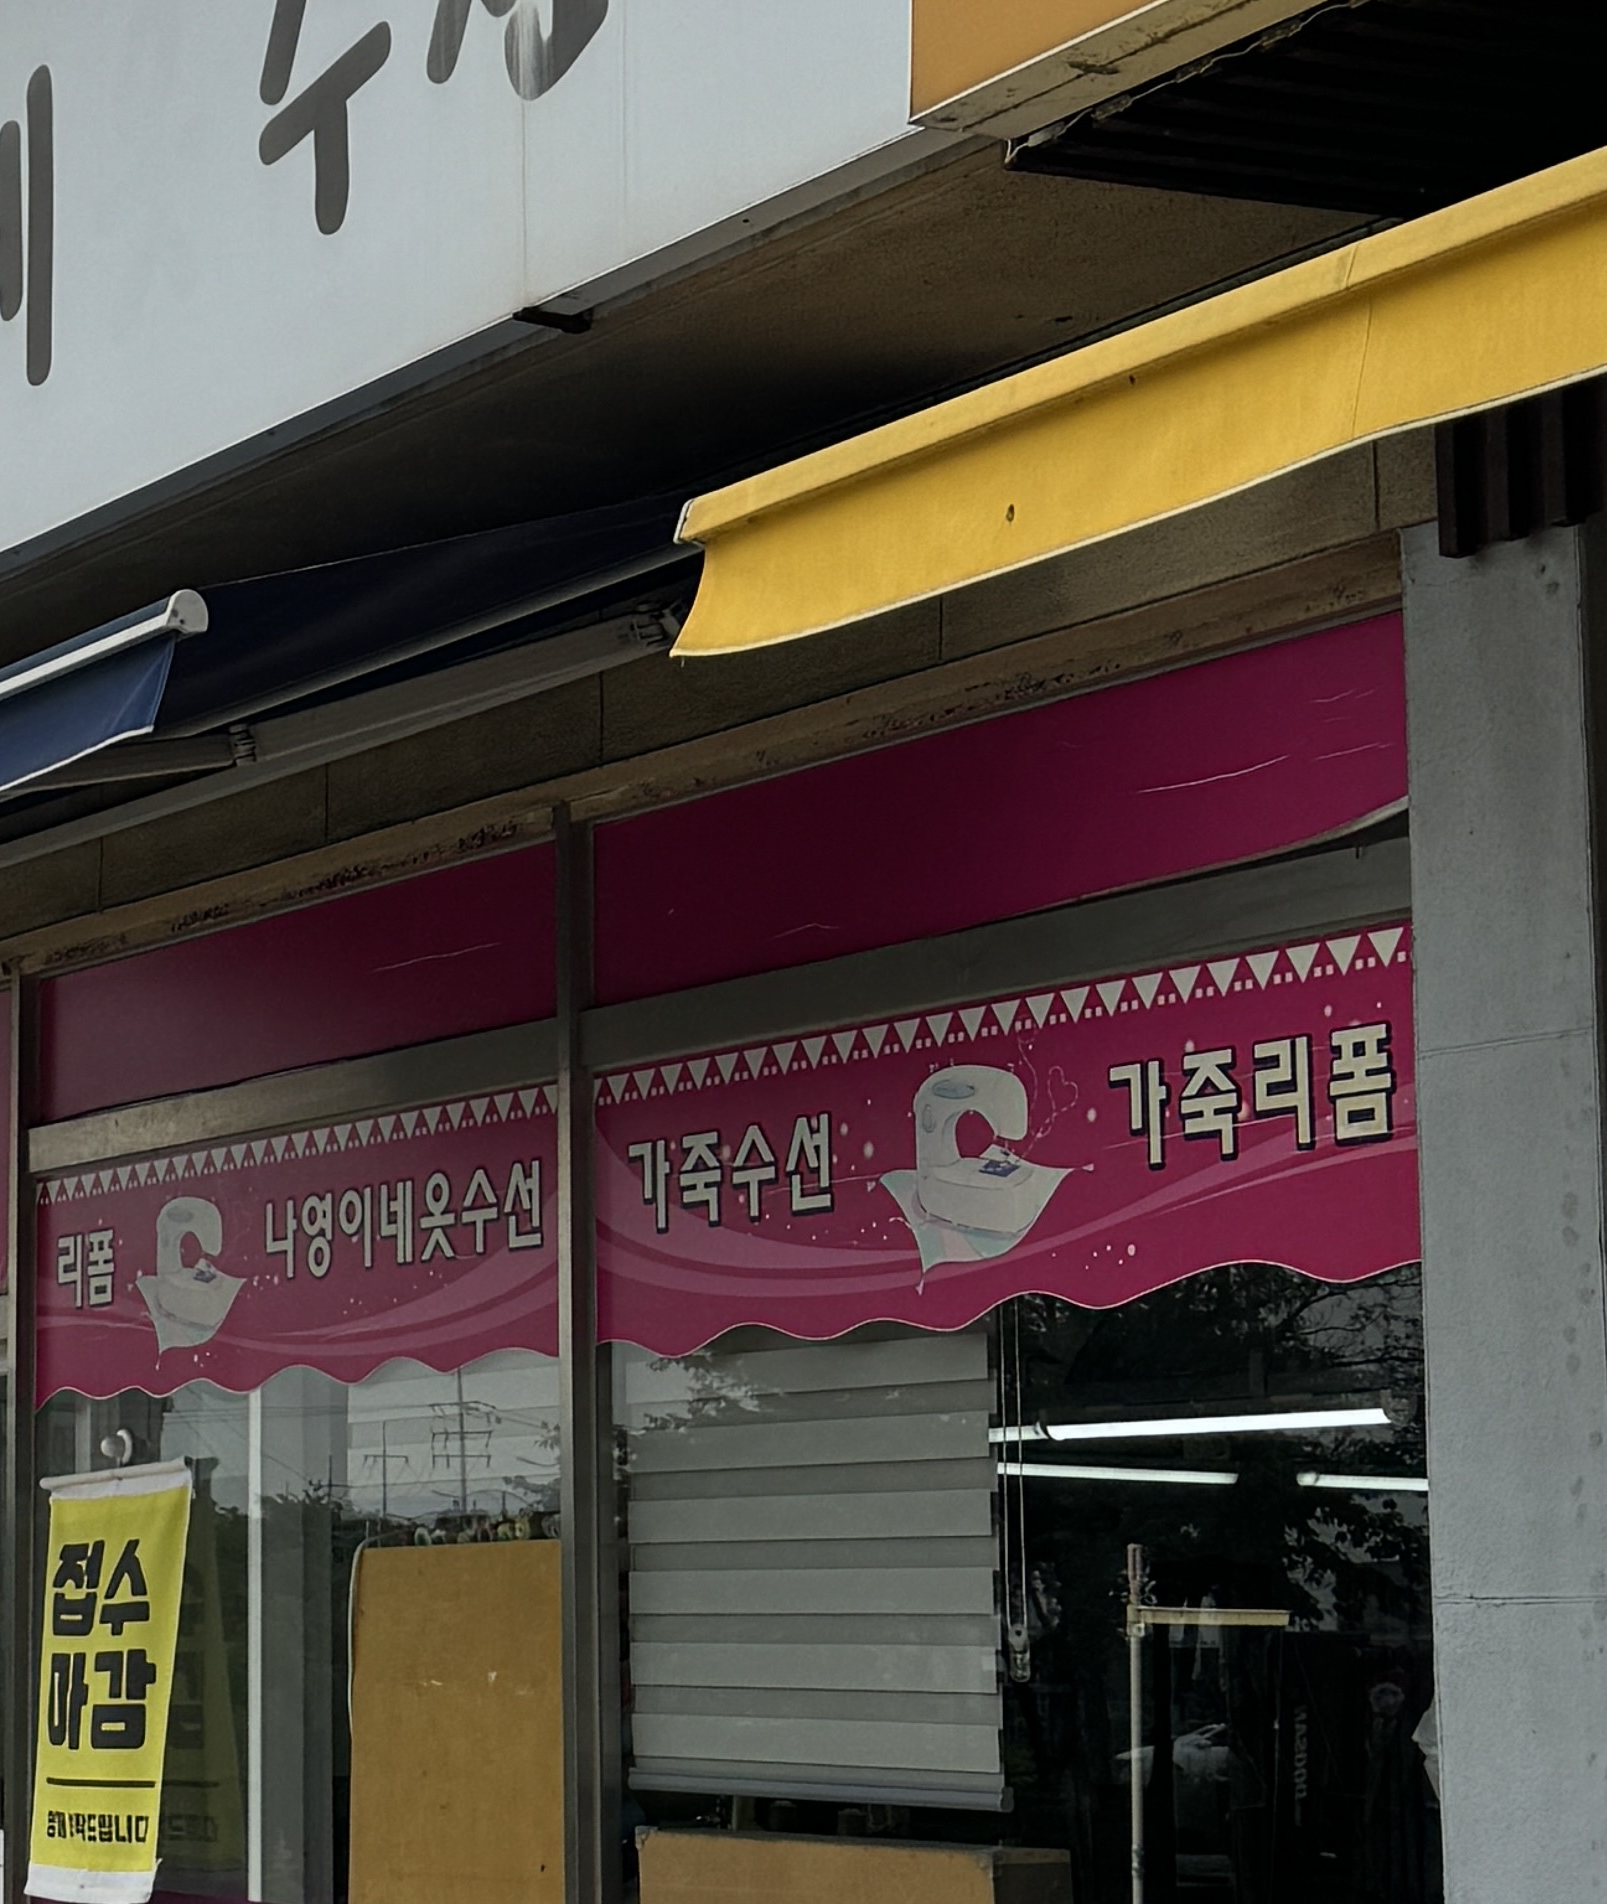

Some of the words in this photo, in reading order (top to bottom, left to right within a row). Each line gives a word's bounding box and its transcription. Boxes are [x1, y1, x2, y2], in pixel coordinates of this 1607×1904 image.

[1107, 1022, 1395, 1170] 가죽리폼
[265, 1156, 546, 1279] 나영이네옷수선
[626, 1110, 836, 1232] 가죽수선
[54, 1222, 117, 1309] 리폼
[52, 1538, 151, 1637] 접수
[47, 1647, 157, 1751] 마감
